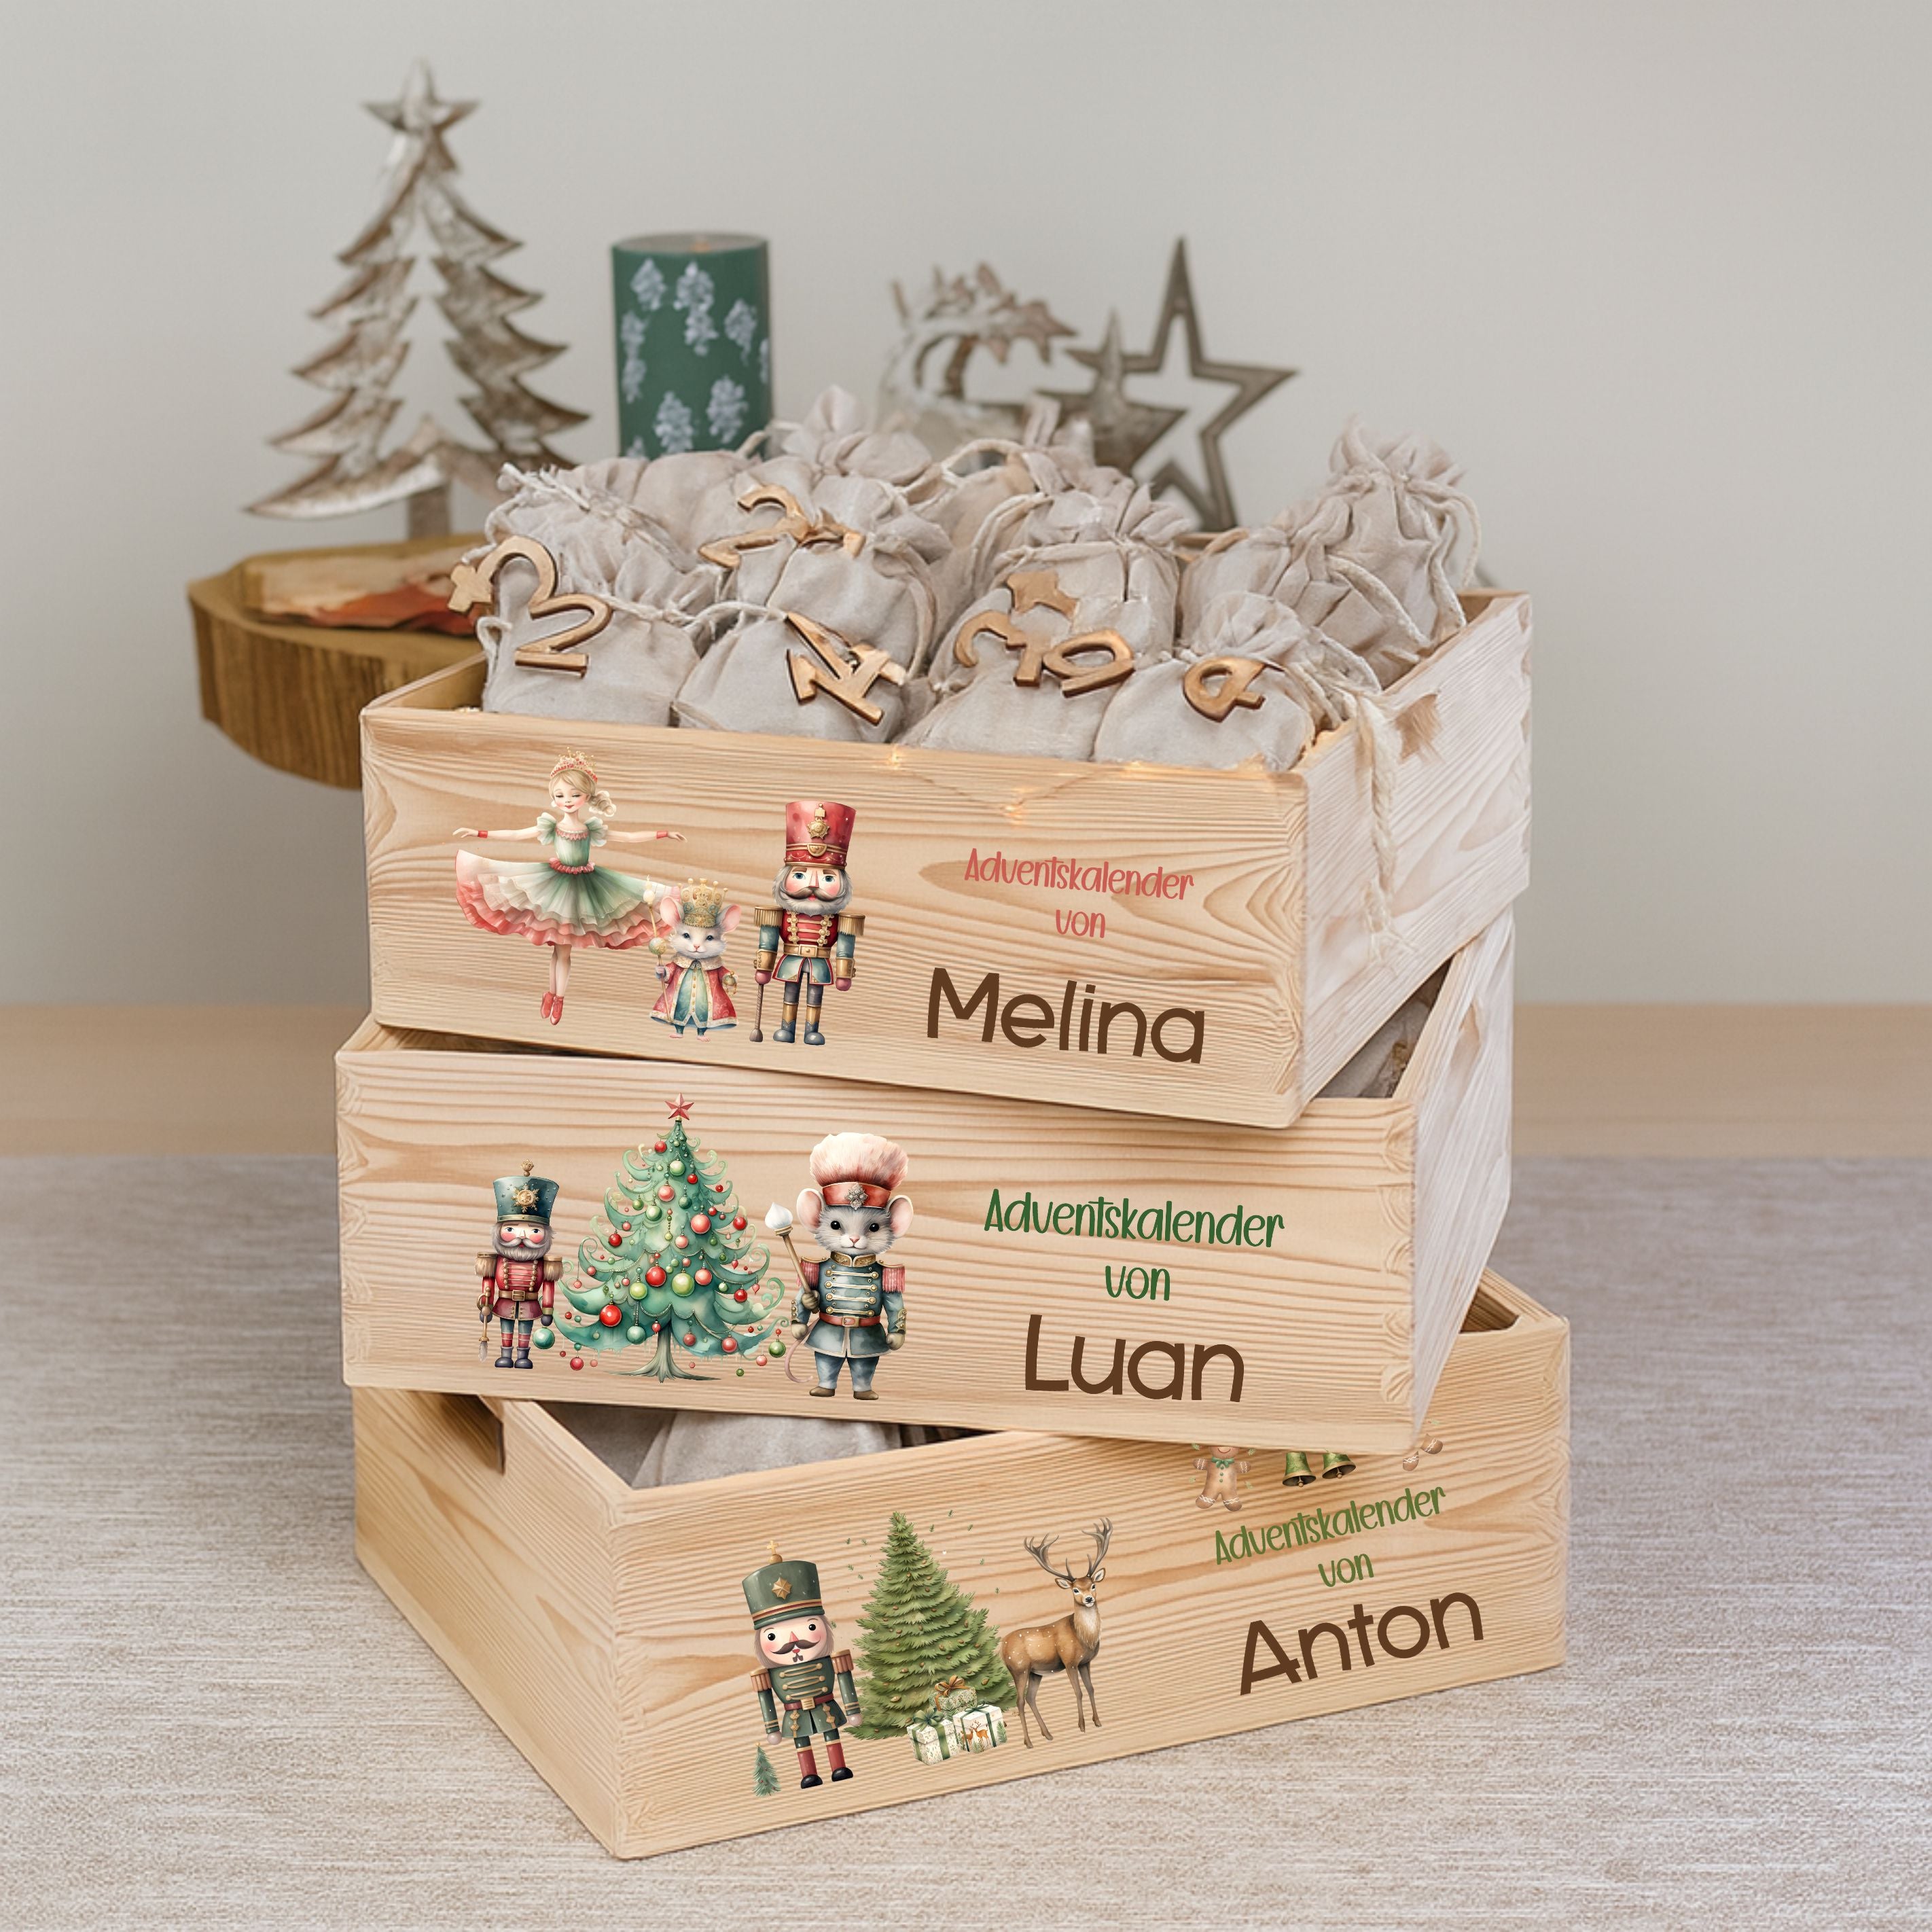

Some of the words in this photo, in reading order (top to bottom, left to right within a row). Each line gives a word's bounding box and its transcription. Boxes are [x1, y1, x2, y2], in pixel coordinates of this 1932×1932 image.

[964, 848, 1194, 900] Adventskalender
[1055, 909, 1106, 938] von
[927, 967, 1205, 1064] Melina
[984, 1188, 1285, 1248] Adventskalender
[1105, 1265, 1170, 1301] von
[1025, 1314, 1245, 1402] Luan
[1215, 1486, 1446, 1565] Adventskalender
[1318, 1553, 1374, 1588] von
[1240, 1592, 1484, 1696] Anton
